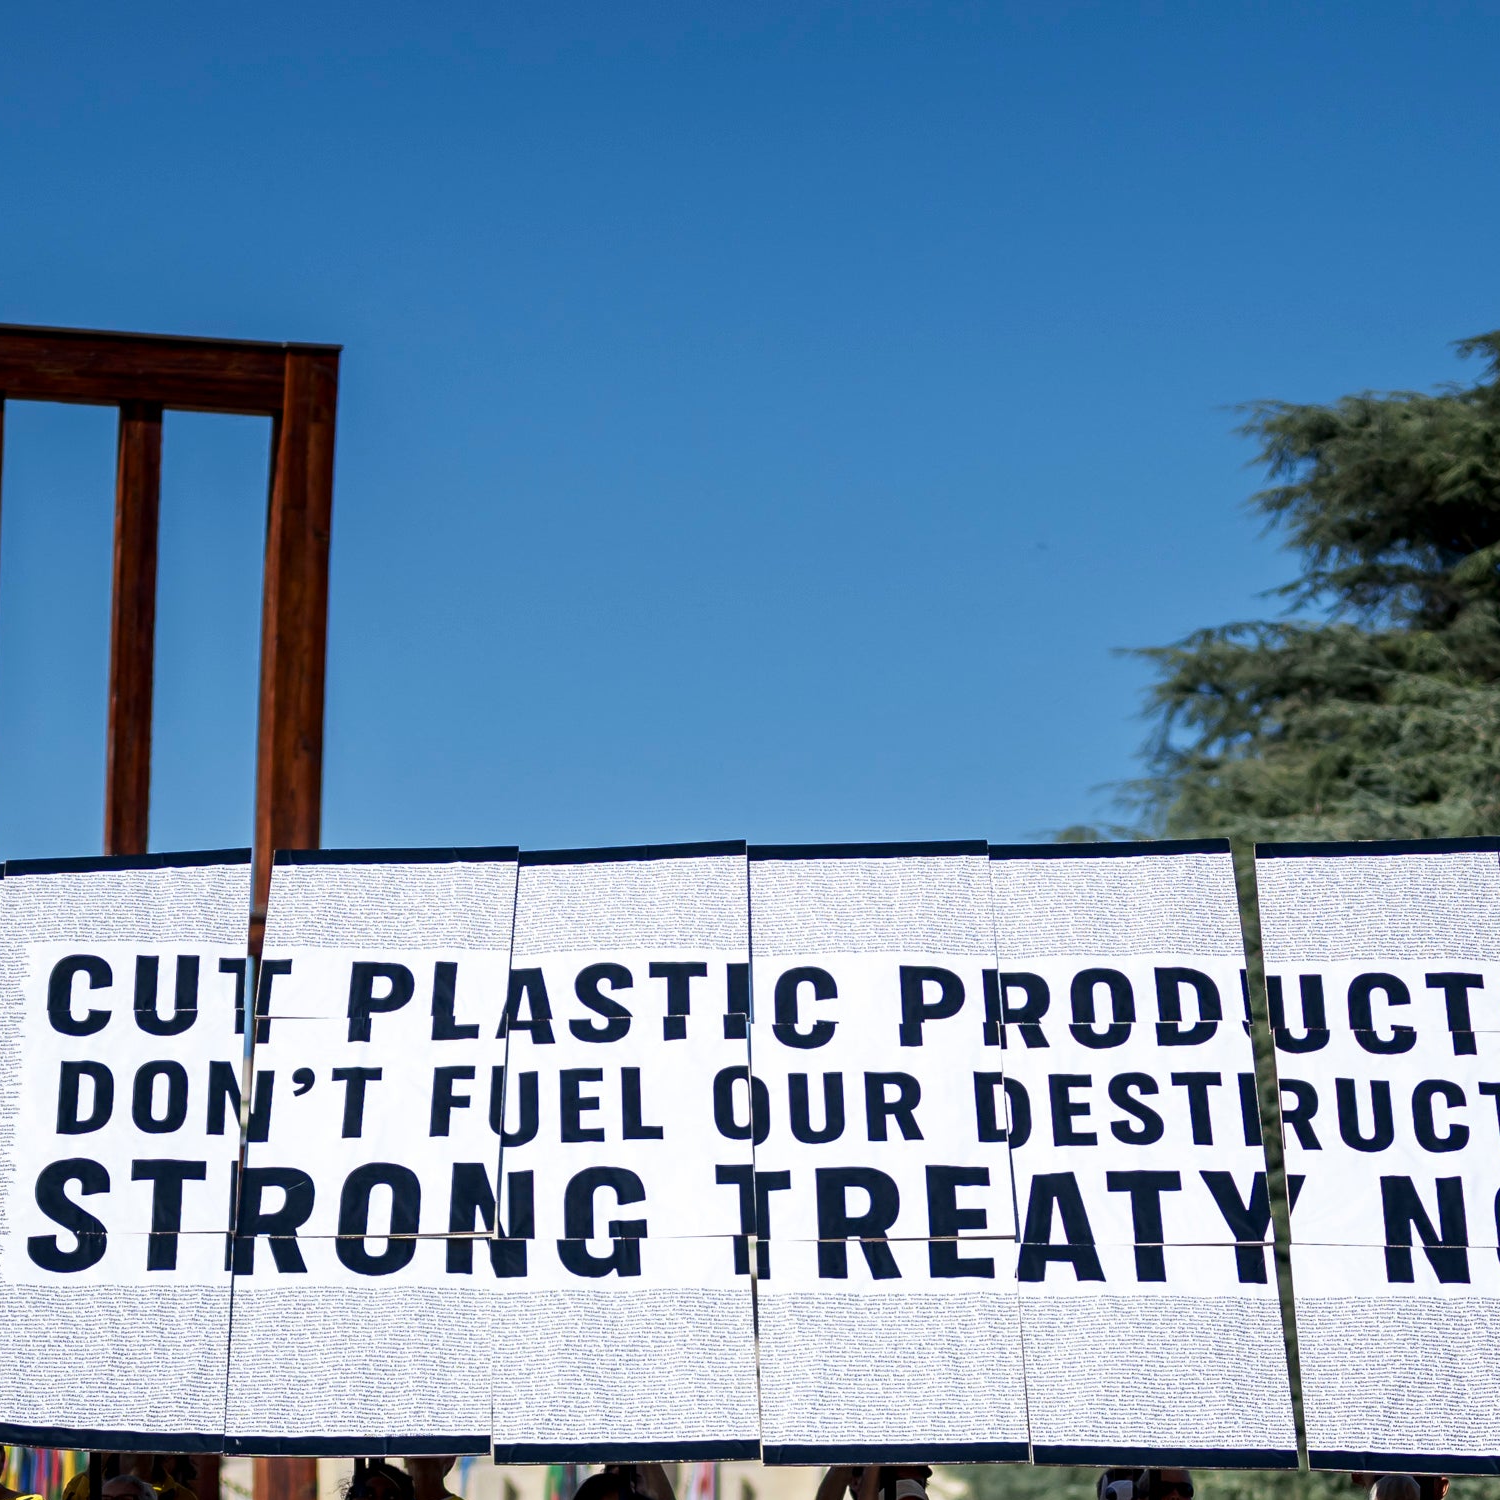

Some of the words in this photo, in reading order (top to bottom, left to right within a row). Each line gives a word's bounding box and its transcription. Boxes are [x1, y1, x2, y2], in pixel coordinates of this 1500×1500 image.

[48, 955, 293, 1043] CUT
[348, 962, 838, 1050] PLASTIC
[57, 1061, 382, 1142] DON’T
[429, 1066, 663, 1147] FUEL
[713, 1066, 924, 1146] OUR
[27, 1158, 647, 1277] STRONG
[716, 1165, 1306, 1284] TREATY
